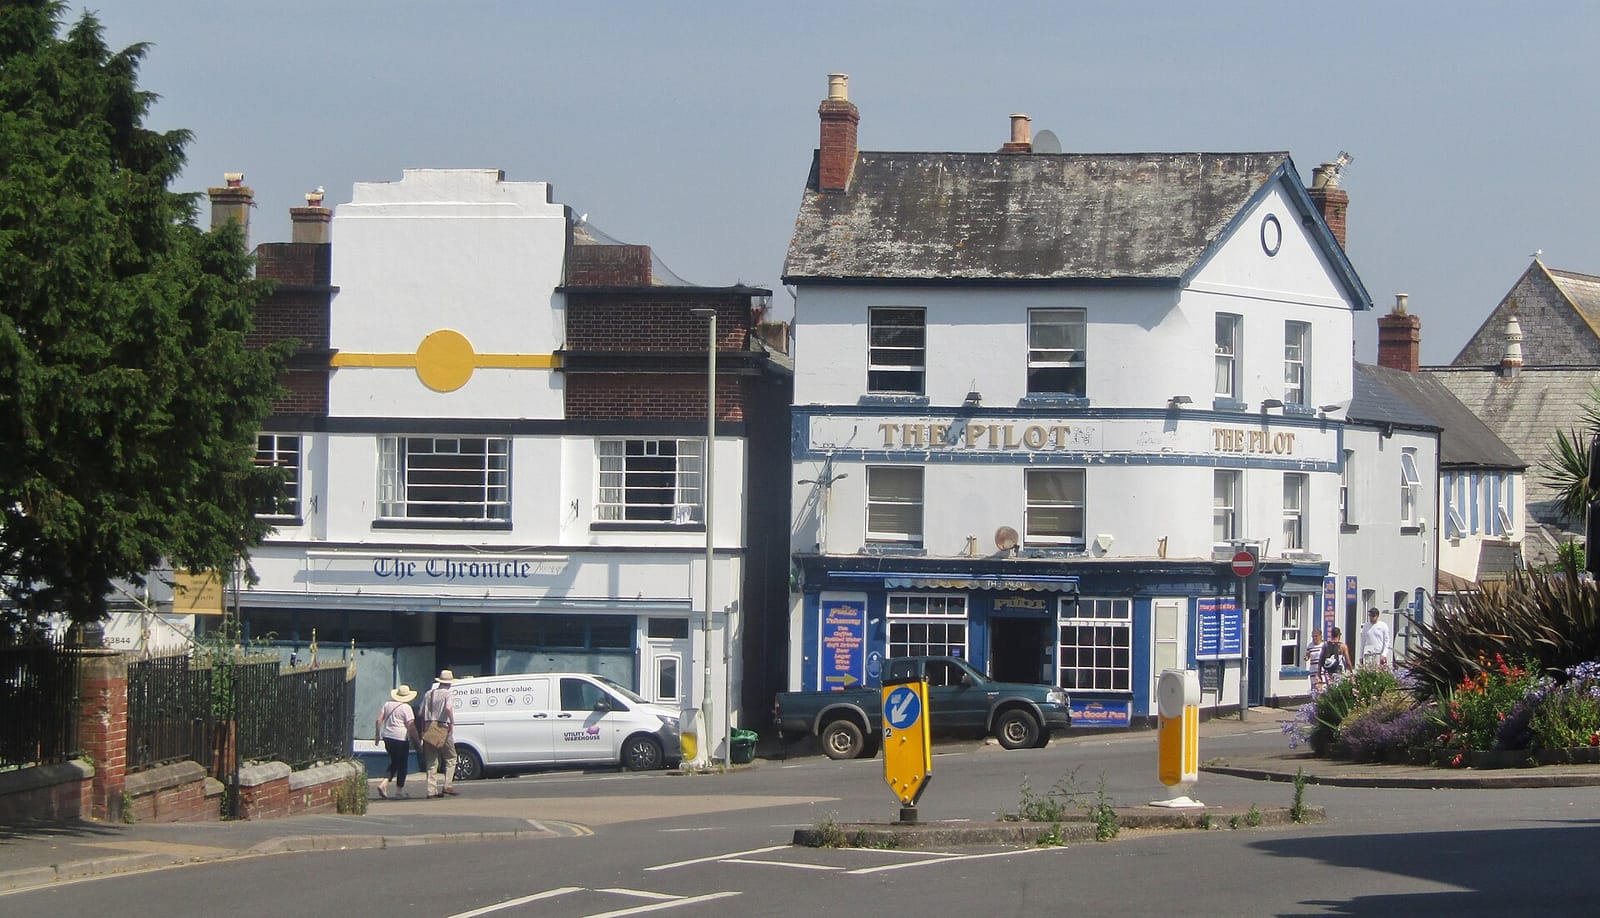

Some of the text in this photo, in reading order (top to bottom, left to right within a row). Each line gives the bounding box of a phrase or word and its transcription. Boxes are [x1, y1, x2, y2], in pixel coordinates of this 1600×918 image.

[878, 423, 947, 448] THE
[965, 424, 1071, 449] PILOT
[1212, 428, 1296, 455] THE PILOT
[373, 557, 417, 581] The
[425, 557, 531, 581] Chronicle
[470, 687, 484, 695] bill.
[485, 686, 509, 694] Better
[511, 685, 535, 693] value.
[885, 728, 892, 738] 2
